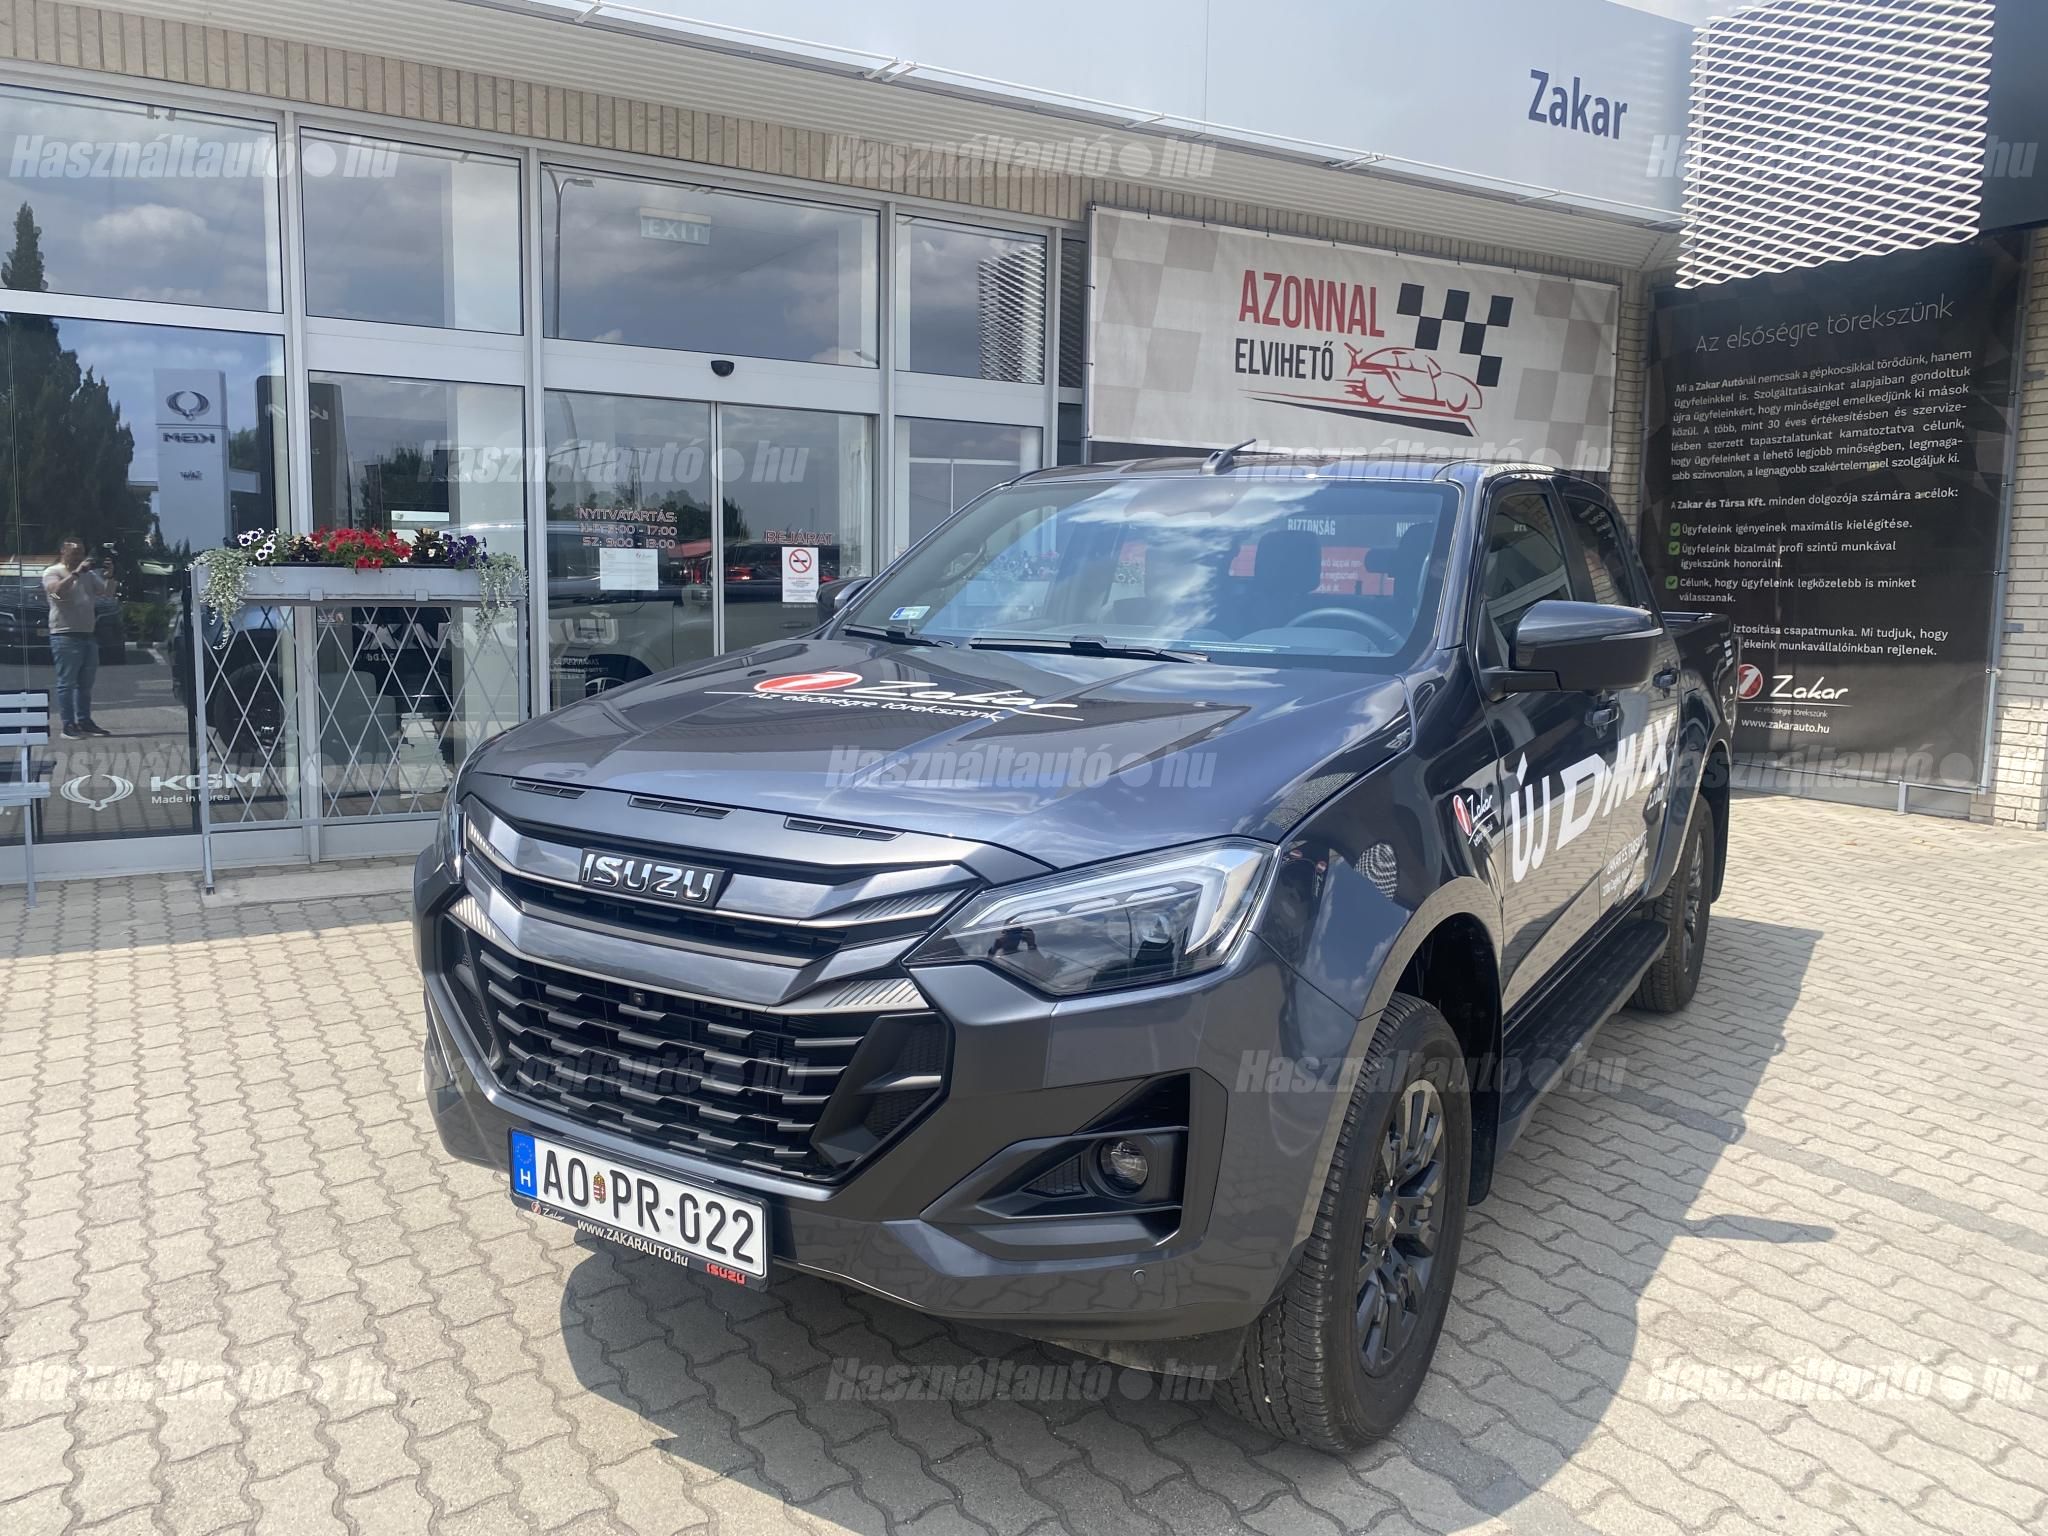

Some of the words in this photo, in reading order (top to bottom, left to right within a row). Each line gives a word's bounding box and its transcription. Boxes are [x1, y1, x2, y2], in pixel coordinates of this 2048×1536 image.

[1529, 69, 1627, 140] Zakar
[648, 219, 705, 241] EXIT
[1238, 269, 1385, 338] AZONNAL
[1696, 334, 1719, 353] Az
[1726, 319, 1819, 348] elsőségre
[1827, 293, 1954, 336] törekszünk
[1235, 338, 1334, 381] ELVIHETŐ
[1675, 383, 1687, 393] Mi
[1696, 381, 1721, 391] Zakar
[1758, 369, 1801, 384] nemcsak
[1802, 371, 1808, 379] a
[1809, 360, 1875, 380] gépkocsikkal
[1877, 354, 1929, 370] törődünk,
[1931, 350, 1972, 363] hanem
[1674, 393, 1734, 410] ügyfeleinkkel
[1739, 391, 1749, 401] is.
[1754, 381, 1845, 400] Szolgáltatásainkat
[1850, 375, 1905, 390] alapjaiban
[1911, 366, 1971, 384] gondoltuk
[1673, 412, 1691, 424] újra
[1693, 407, 1756, 423] ügyfeleinkért,
[1758, 405, 1781, 416] hogy
[1784, 397, 1840, 412] minőséggel
[1843, 390, 1912, 407] emelkedjünk
[1914, 388, 1925, 399] ki
[1928, 383, 1969, 397] mások
[1703, 426, 1710, 435] A
[1714, 424, 1737, 434] több,
[1741, 420, 1763, 432] mint
[1767, 419, 1780, 429] 30
[1784, 415, 1807, 428] éves
[1810, 410, 1889, 425] értékesítésben
[1894, 407, 1907, 417] és
[1912, 403, 1967, 416] szervize-
[1671, 442, 1702, 451] lésben
[1708, 437, 1744, 449] szerzett
[1750, 431, 1833, 447] tapasztalatunkat
[1840, 423, 1915, 439] kamatoztatva
[1923, 418, 1965, 432] célunk,
[1671, 457, 1691, 467] hogy
[1694, 450, 1751, 466] ügyfeleinket
[1753, 453, 1759, 461] a
[1763, 448, 1794, 461] lehető
[1796, 445, 1833, 459] legjobb
[1837, 441, 1905, 454] minőségben,
[1909, 437, 1963, 451] legmaga-
[1755, 463, 1807, 477] legnagyobb
[1809, 457, 1889, 473] szakértelemmel
[1892, 454, 1945, 468] szolgáljuk
[1948, 452, 1960, 464] ki.
[1671, 502, 1677, 510] A
[1677, 500, 1703, 509] Zakar
[1705, 499, 1717, 509] és
[1720, 498, 1746, 508] Társa
[1747, 498, 1766, 507] Kft.
[1769, 495, 1806, 506] minden
[1808, 492, 1858, 506] dolgozója
[1861, 490, 1911, 502] számára
[1914, 492, 1921, 500] a
[1924, 487, 1959, 499] célok:
[765, 528, 833, 545] BEJÁRAT
[1682, 523, 1732, 536] Ügyfeleink
[1735, 522, 1787, 535] igényeinek
[1790, 520, 1843, 532] maximális
[1846, 518, 1913, 531] kielégítése.
[1682, 543, 1730, 556] Ügyfeleink
[1734, 544, 1776, 553] bizalmát
[1779, 542, 1804, 554] profi
[1806, 541, 1838, 552] szintű
[1841, 540, 1897, 552] munkával
[1680, 558, 1730, 570] igyekszünk
[1733, 557, 1783, 569] honorálni.
[1679, 576, 1712, 589] Célunk,
[1714, 578, 1738, 589] hogy
[1741, 577, 1794, 590] ügyfeleink
[1797, 577, 1862, 590] legközelebb
[1865, 578, 1874, 588] is
[1877, 578, 1917, 588] minket
[1679, 592, 1737, 603] válasszanak.
[1733, 624, 1781, 635] iztosítása
[1783, 626, 1858, 638] csapatmunka.
[1860, 627, 1874, 637] Mi
[1876, 627, 1916, 641] tudjuk,
[1920, 628, 1949, 641] hogy
[1779, 641, 1884, 655] munkavállalóinkban
[1887, 644, 1937, 657] rejlenek.
[1769, 674, 1849, 700] Zakar
[1741, 719, 1831, 734] www.zakarauto.hu
[150, 772, 262, 792] KGM
[151, 795, 183, 804] Made
[186, 794, 196, 802] in
[1510, 751, 1550, 883] ÚJ
[582, 853, 715, 903] ISUZU
[543, 1150, 589, 1208] AO
[609, 1169, 754, 1265] PR-022
[705, 1262, 746, 1285] ISUZU
